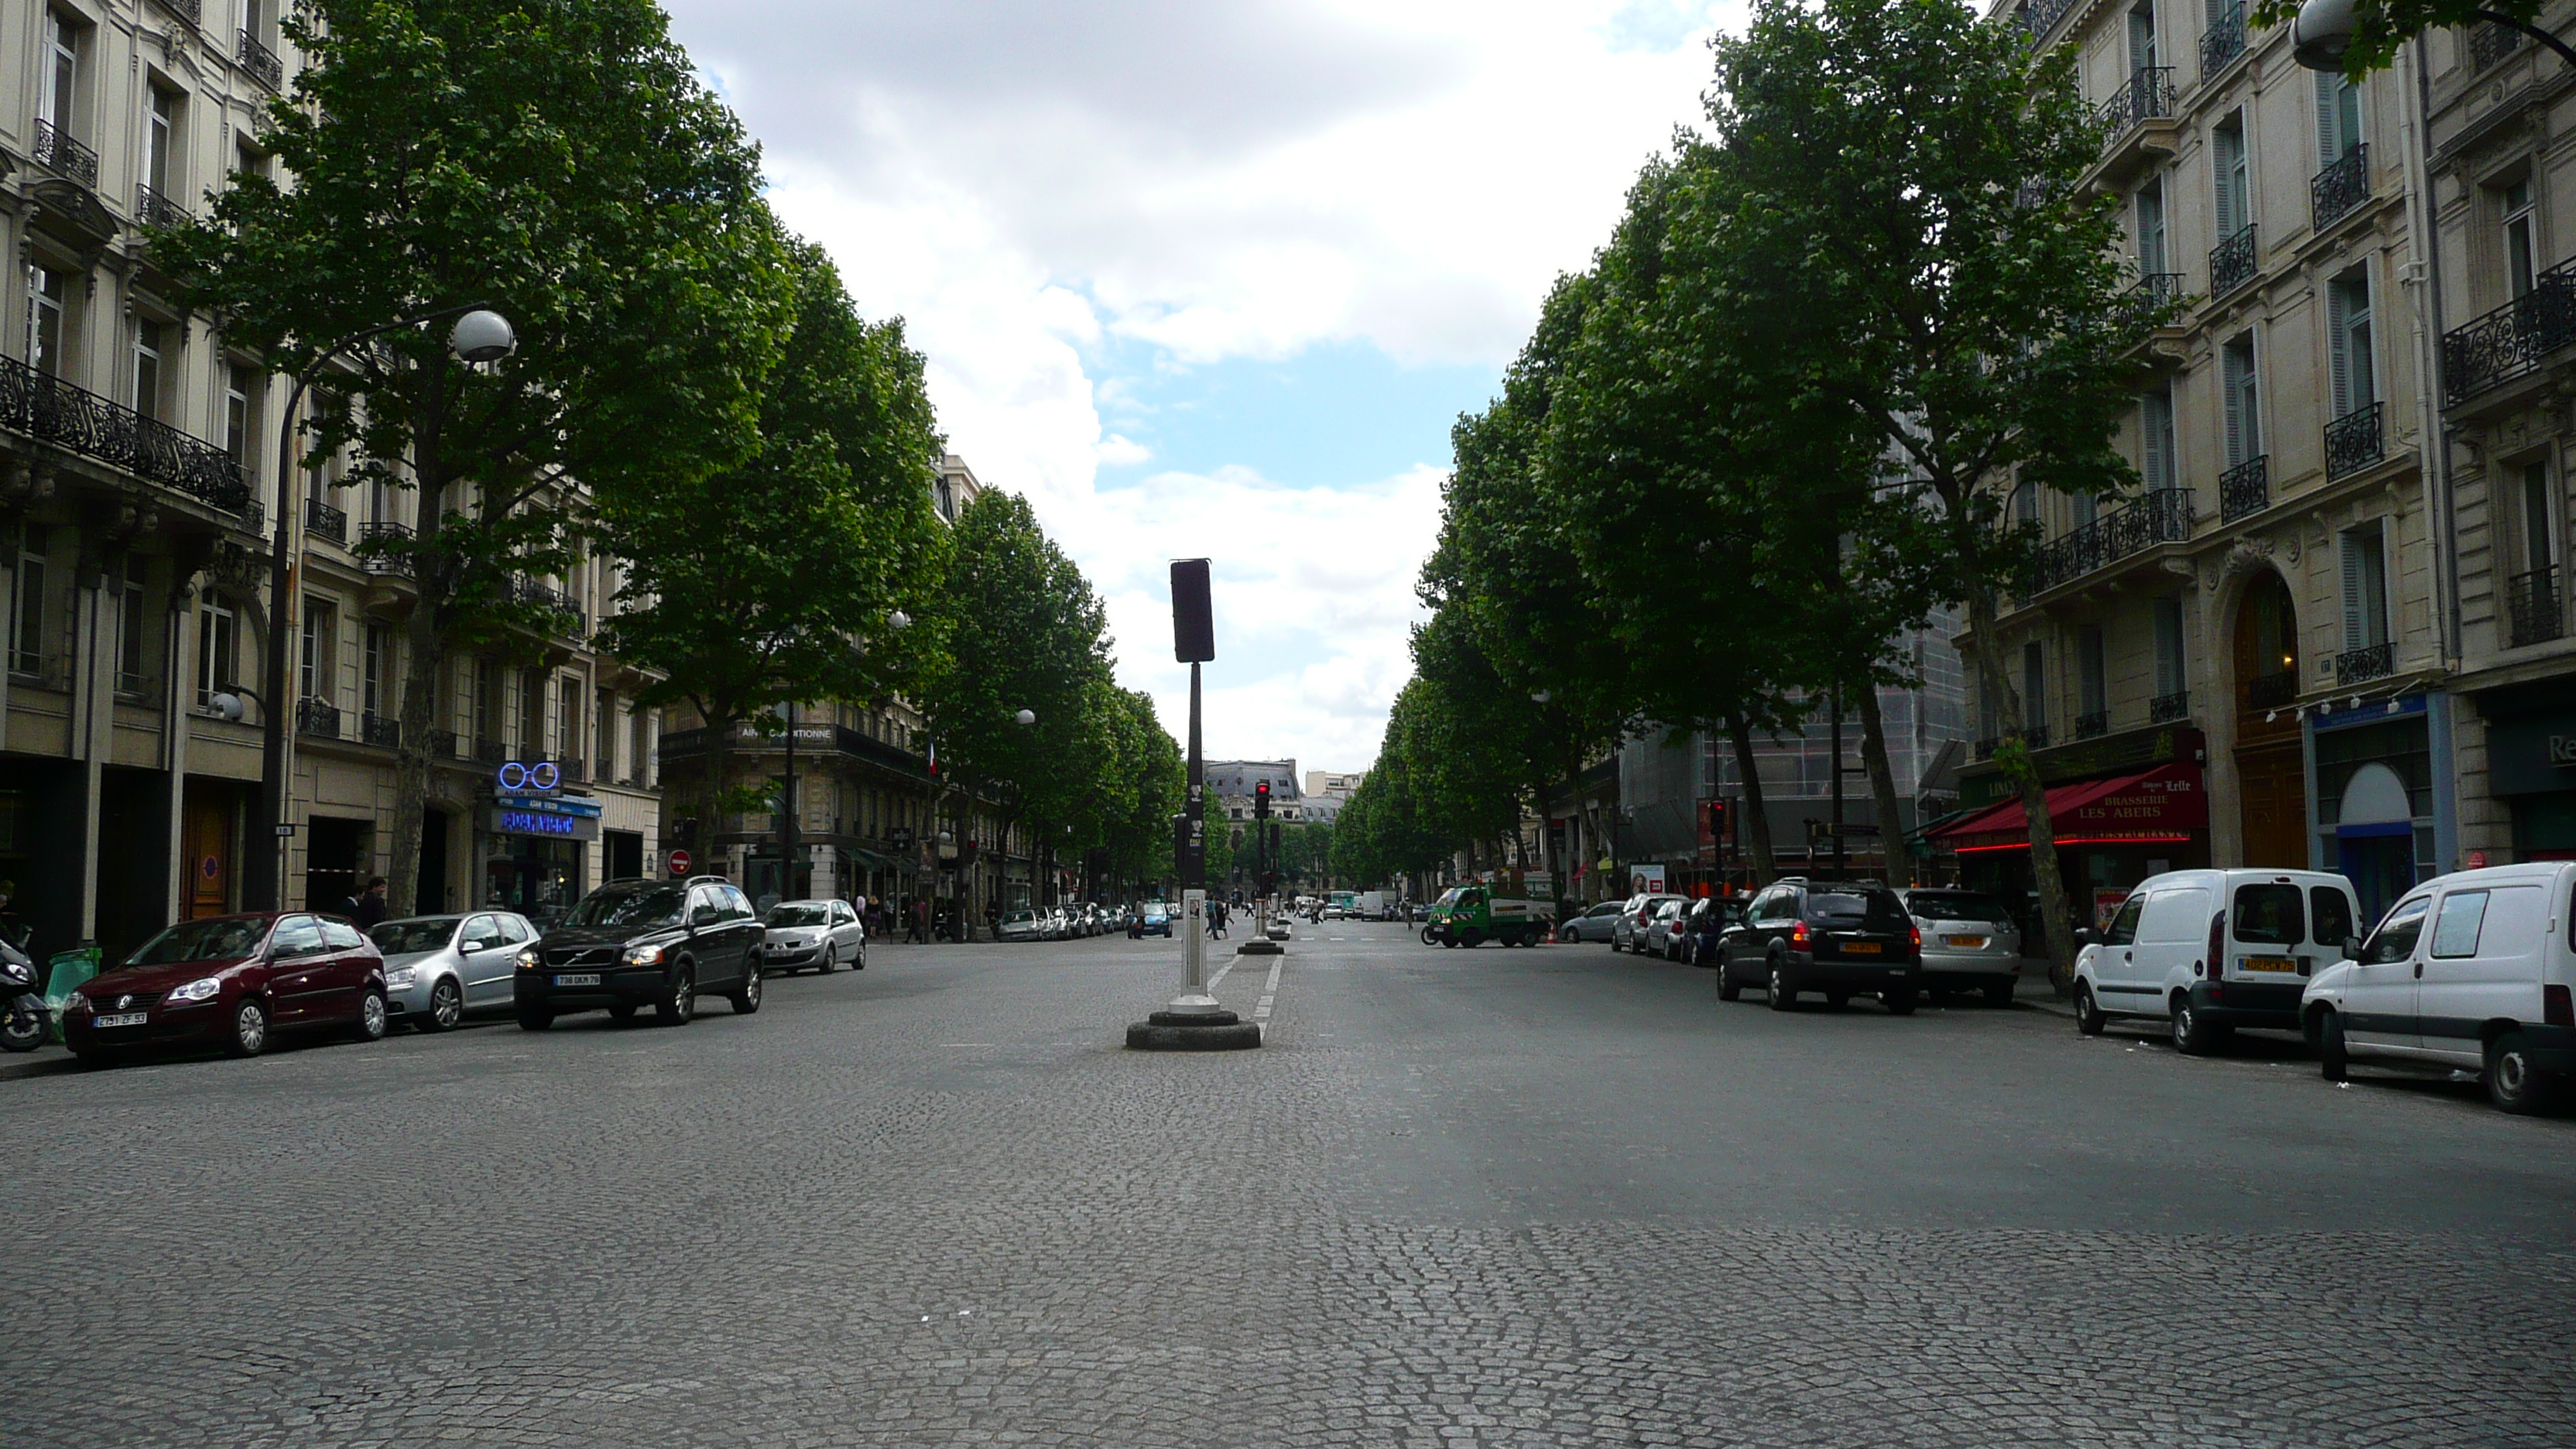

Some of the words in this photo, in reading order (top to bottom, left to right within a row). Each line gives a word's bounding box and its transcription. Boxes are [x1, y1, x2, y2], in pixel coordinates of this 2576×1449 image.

[2104, 795, 2169, 807] BRASSERIE
[2079, 808, 2106, 819] LES
[2113, 807, 2162, 819] ABERS
